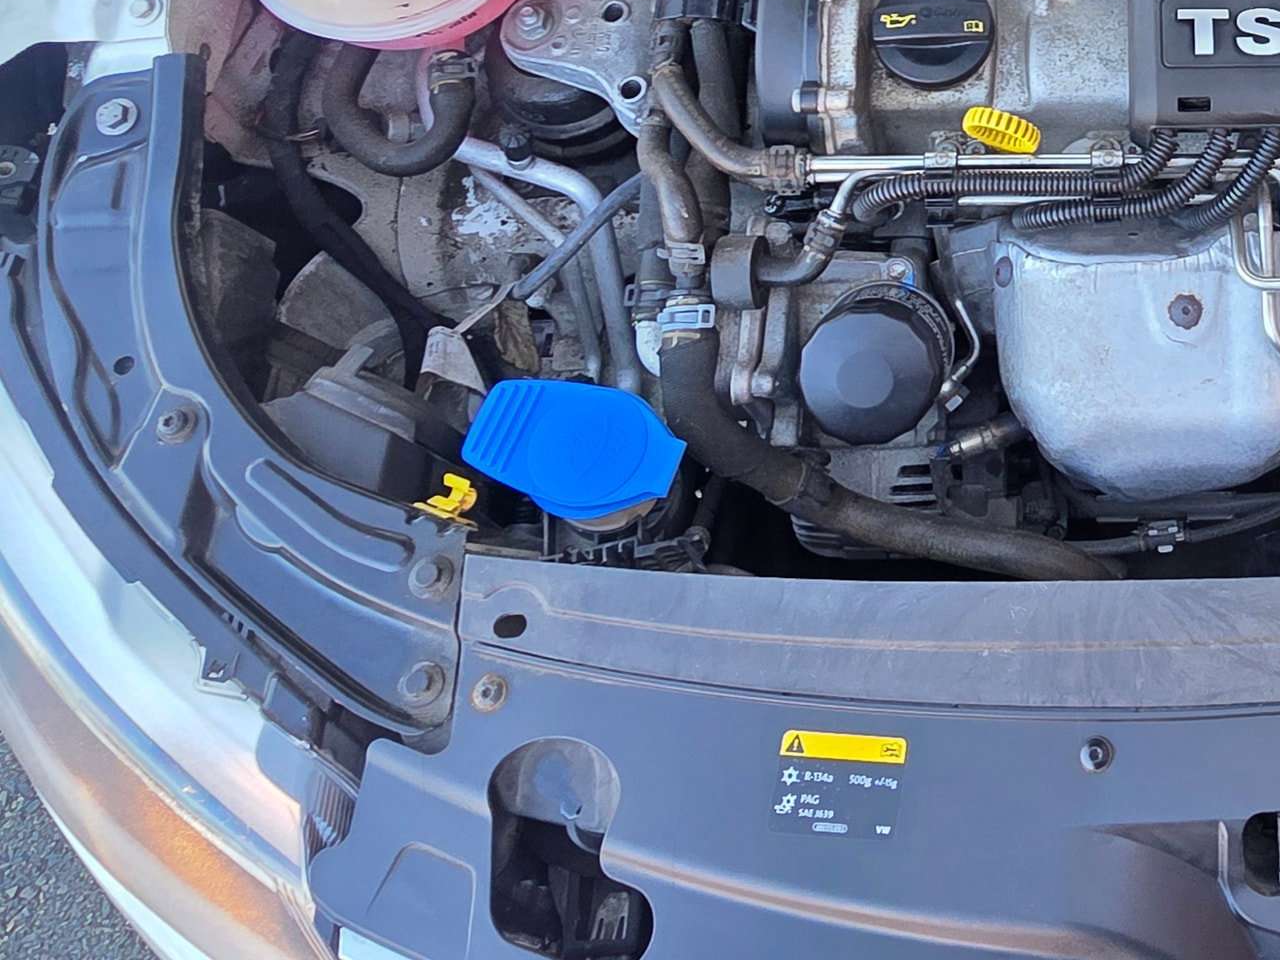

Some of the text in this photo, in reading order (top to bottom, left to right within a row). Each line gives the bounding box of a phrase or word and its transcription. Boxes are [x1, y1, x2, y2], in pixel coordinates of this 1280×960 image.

[848, 773, 872, 788] 500g
[800, 794, 820, 805] PAG
[798, 808, 813, 818] SAE
[875, 825, 891, 835] VW
